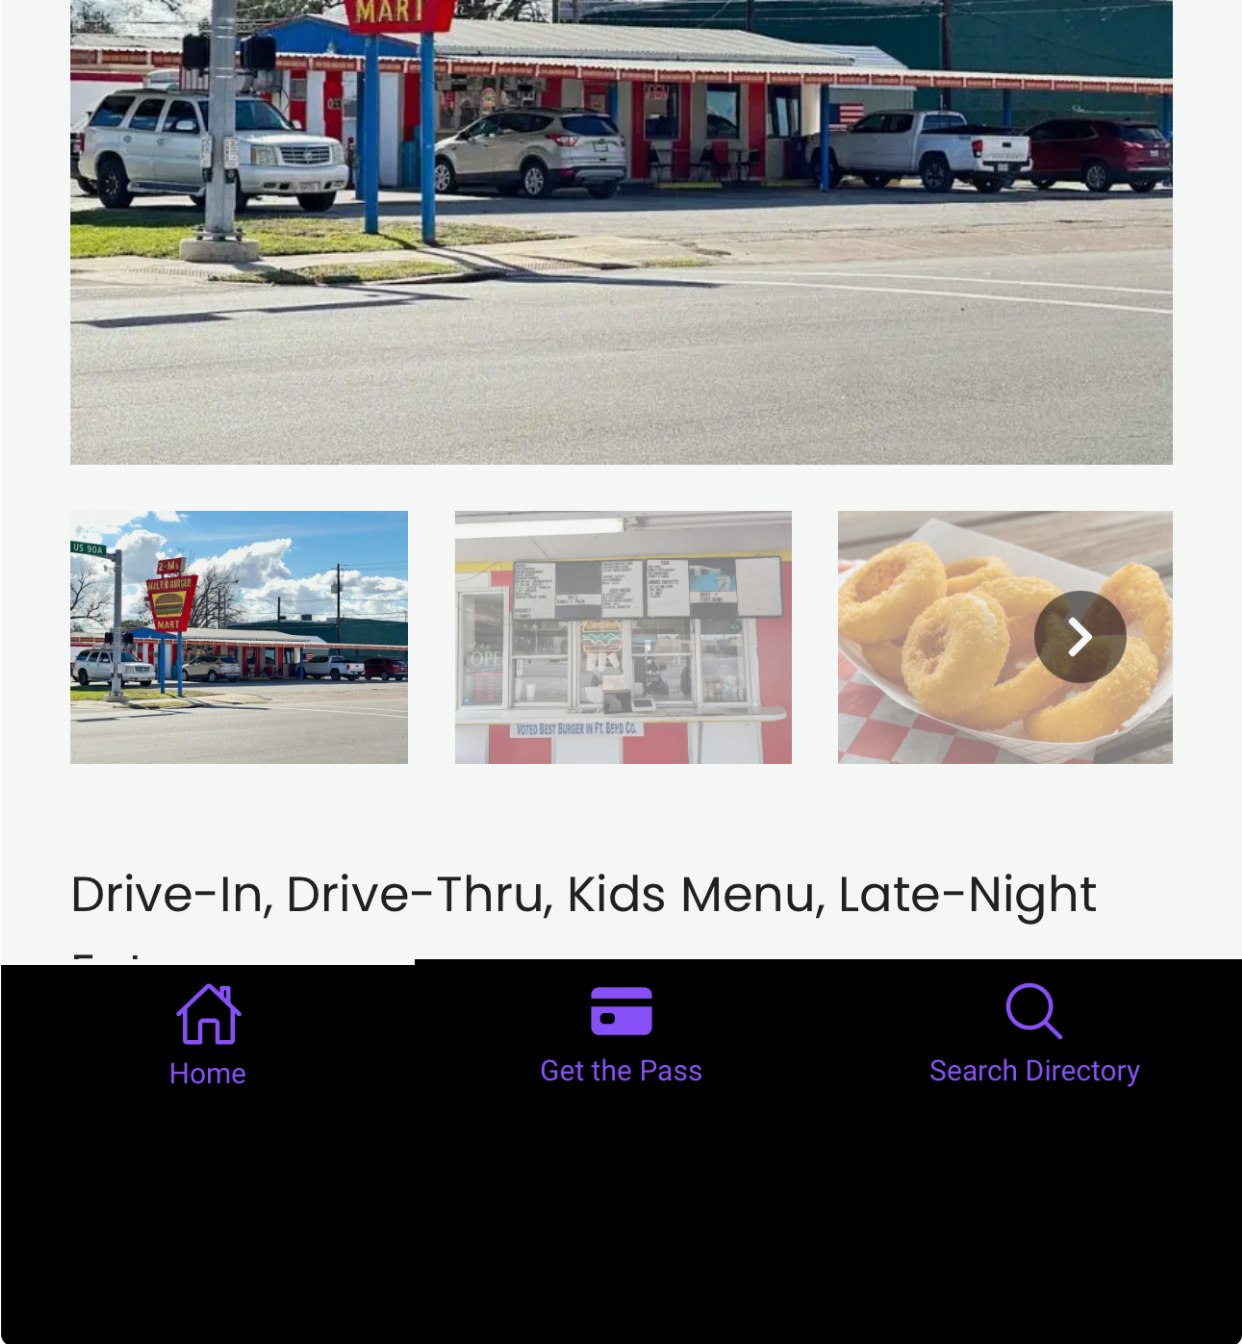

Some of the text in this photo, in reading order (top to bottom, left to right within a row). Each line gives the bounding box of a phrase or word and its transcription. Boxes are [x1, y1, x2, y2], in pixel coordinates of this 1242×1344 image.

[73, 543, 103, 554] US 90A
[170, 578, 191, 589] BURGER
[157, 620, 179, 630] MART
[470, 651, 501, 666] OPE
[516, 723, 538, 735] VOTED
[540, 723, 556, 735] BEST
[558, 722, 584, 735] BURGER
[74, 873, 1096, 925] Drive-In, Drive-Thru, Kids Menu, Late-Night
[170, 1061, 247, 1085] Home
[541, 1058, 703, 1082] Get the Pass
[930, 1058, 1141, 1088] Search Directory
